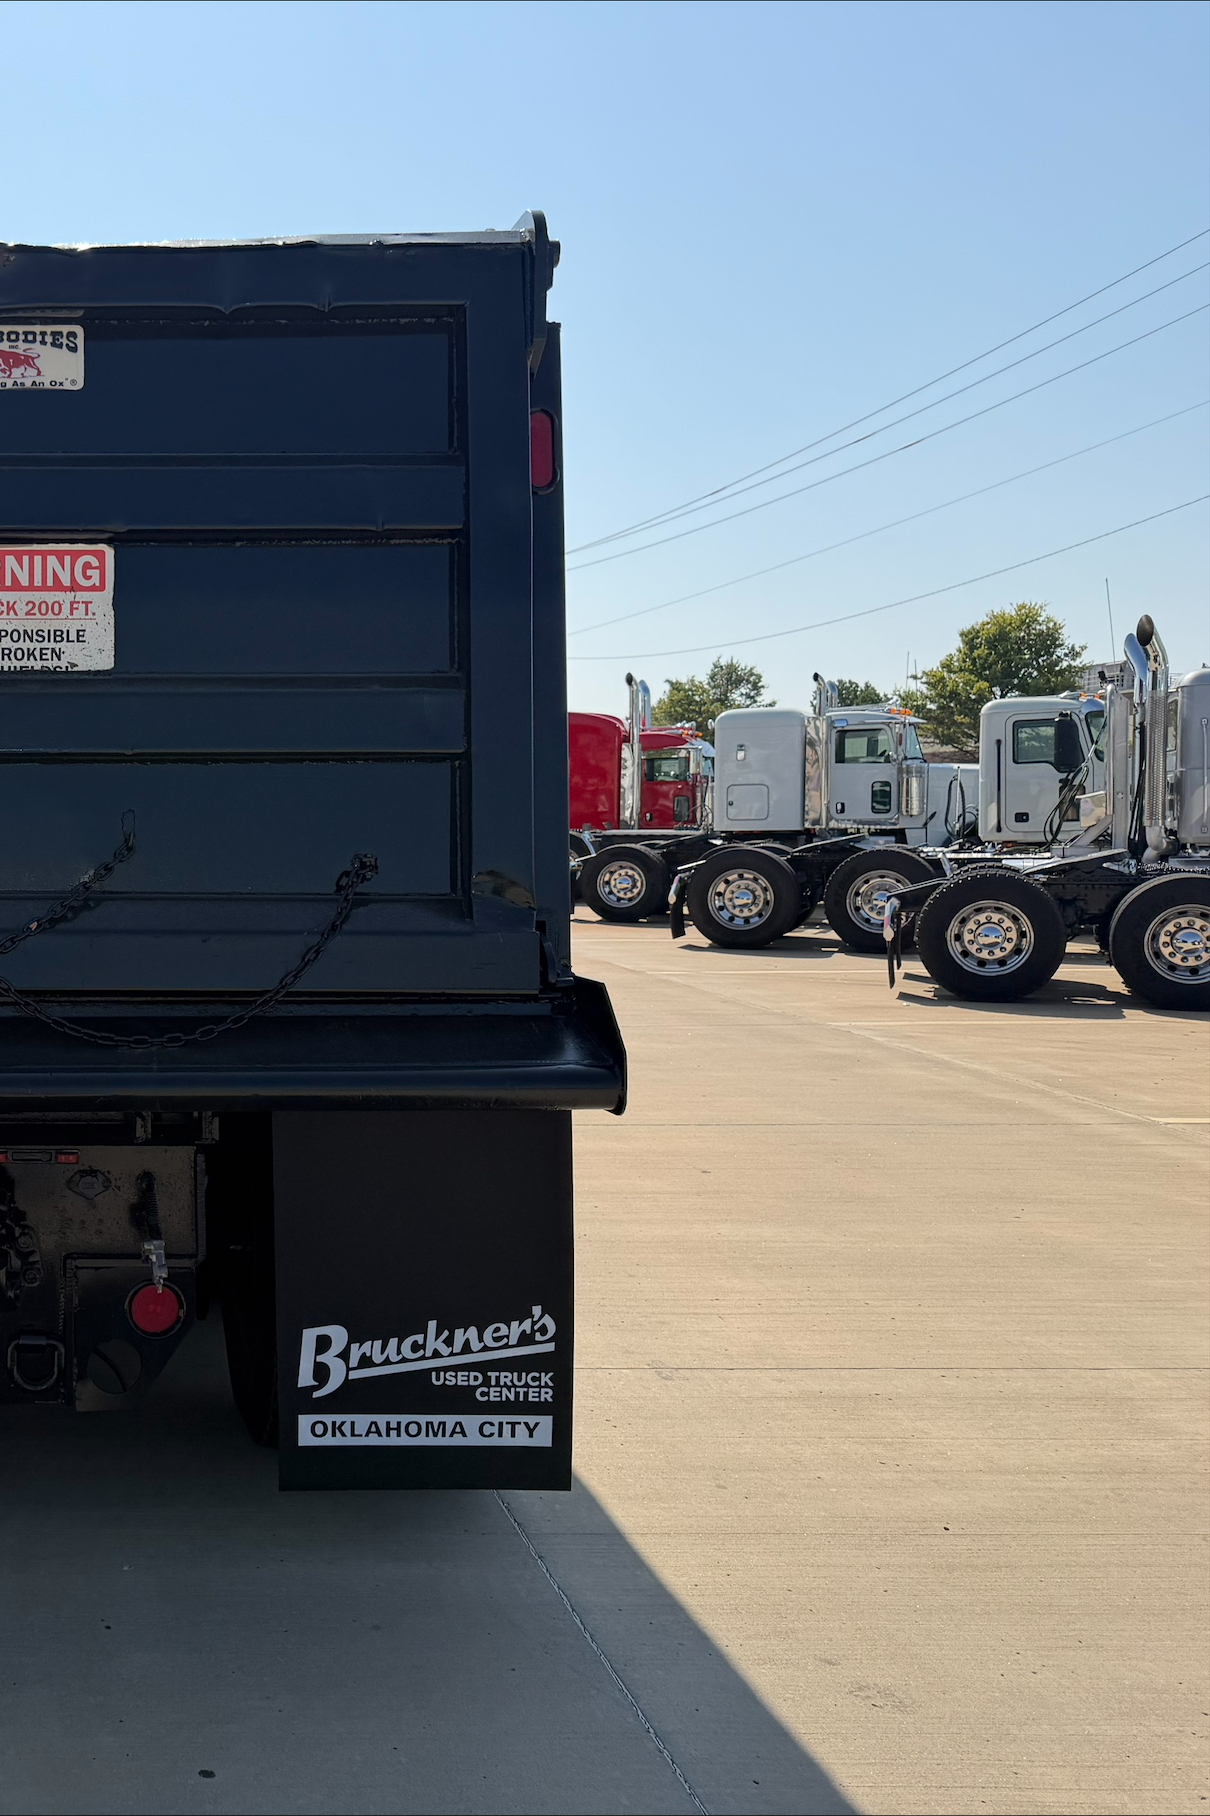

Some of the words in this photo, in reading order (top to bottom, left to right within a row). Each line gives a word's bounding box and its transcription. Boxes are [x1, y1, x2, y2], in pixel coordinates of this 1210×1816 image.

[25, 600, 63, 617] 200
[69, 600, 96, 617] FT.
[297, 1304, 556, 1398] Bruckner's
[431, 1371, 483, 1386] USED
[487, 1371, 554, 1386] TRUCK
[475, 1387, 553, 1402] CENTER
[310, 1420, 468, 1438] OKLAHOMA
[478, 1421, 541, 1438] CITY
